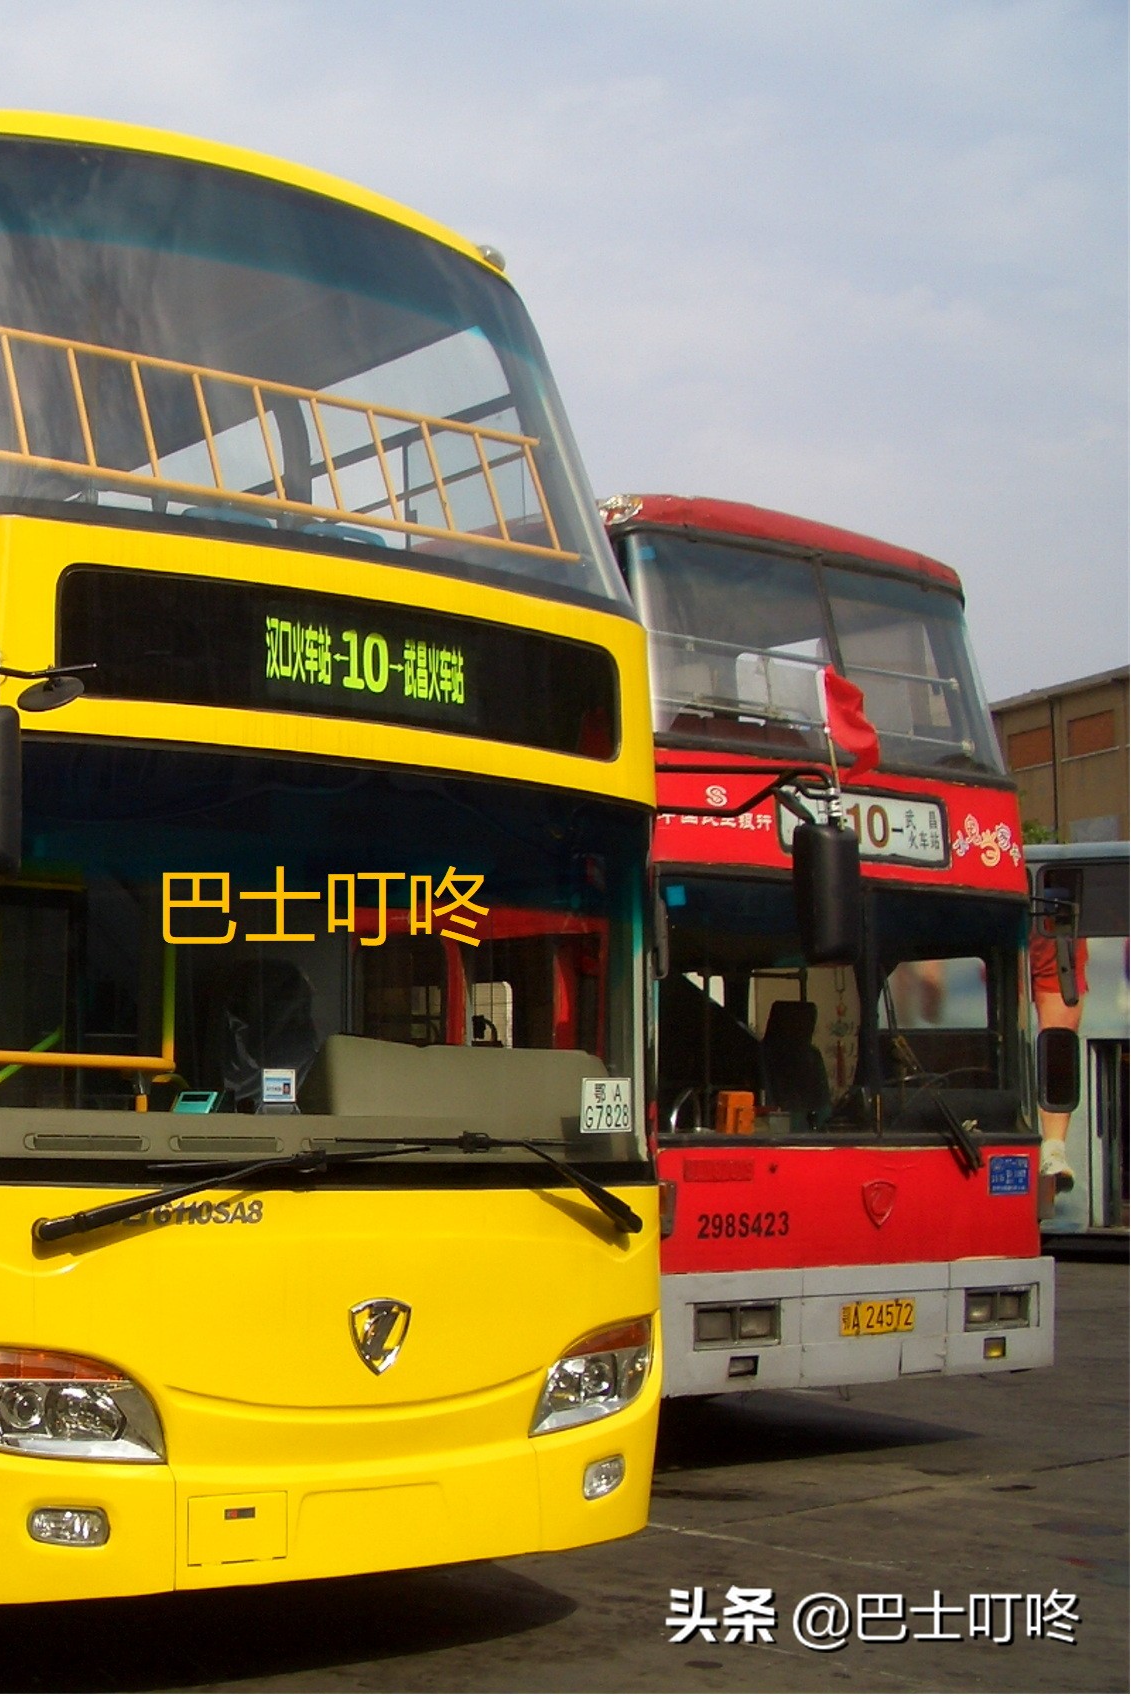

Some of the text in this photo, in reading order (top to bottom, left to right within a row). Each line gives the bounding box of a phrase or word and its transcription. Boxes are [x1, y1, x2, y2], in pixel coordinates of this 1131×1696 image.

[266, 615, 464, 703] 汉口火车站 10 武昌火车站
[846, 803, 889, 849] 10
[585, 1104, 629, 1130] G7828
[697, 1211, 789, 1239] 298S423
[866, 1303, 913, 1329] 24572
